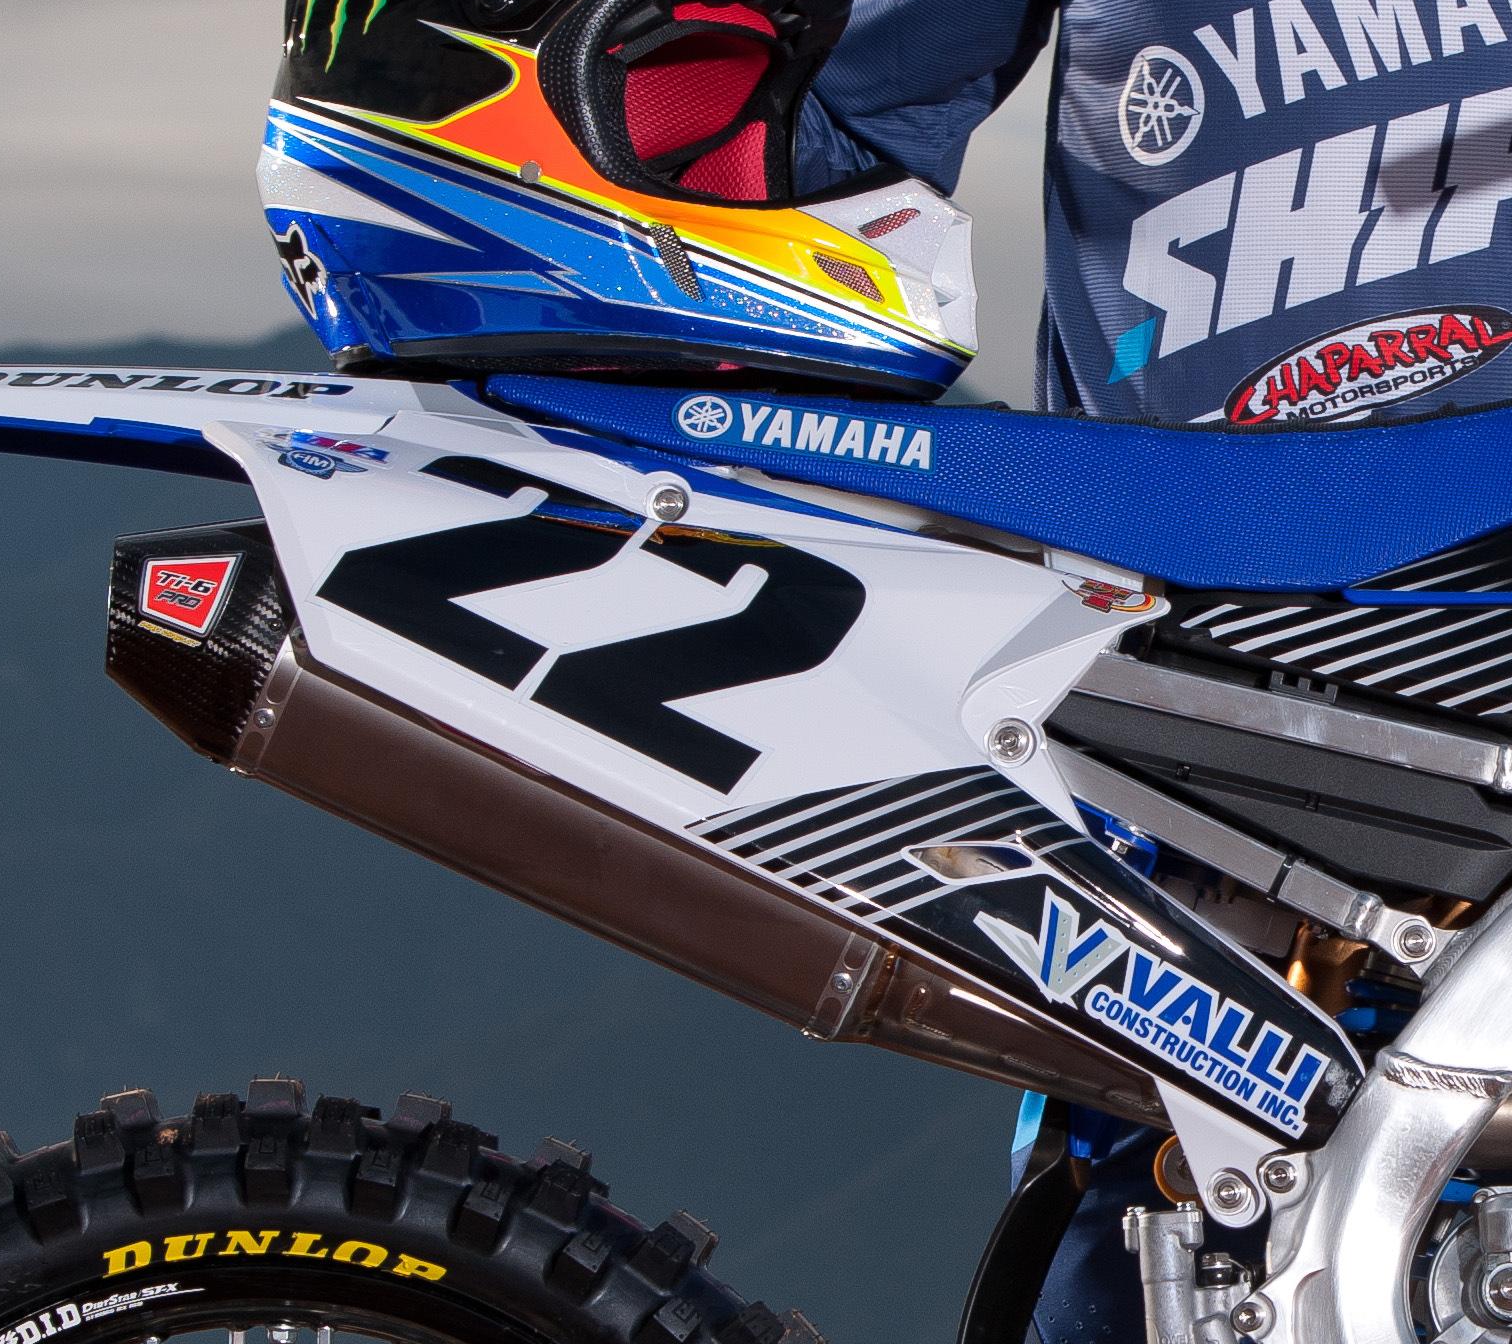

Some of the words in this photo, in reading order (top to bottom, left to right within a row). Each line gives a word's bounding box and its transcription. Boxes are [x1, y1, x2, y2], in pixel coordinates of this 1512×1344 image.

[1287, 355, 1478, 423] MOTORSPORTS
[738, 401, 934, 471] YAMAHA
[155, 589, 202, 610] PRO
[156, 570, 217, 596] Ti-6
[315, 455, 867, 796] 22
[1091, 991, 1257, 1099] CONSTRUCTION
[1256, 1089, 1303, 1131] INC.
[1128, 951, 1326, 1102] VALLI
[102, 1230, 448, 1281] DUNLOP
